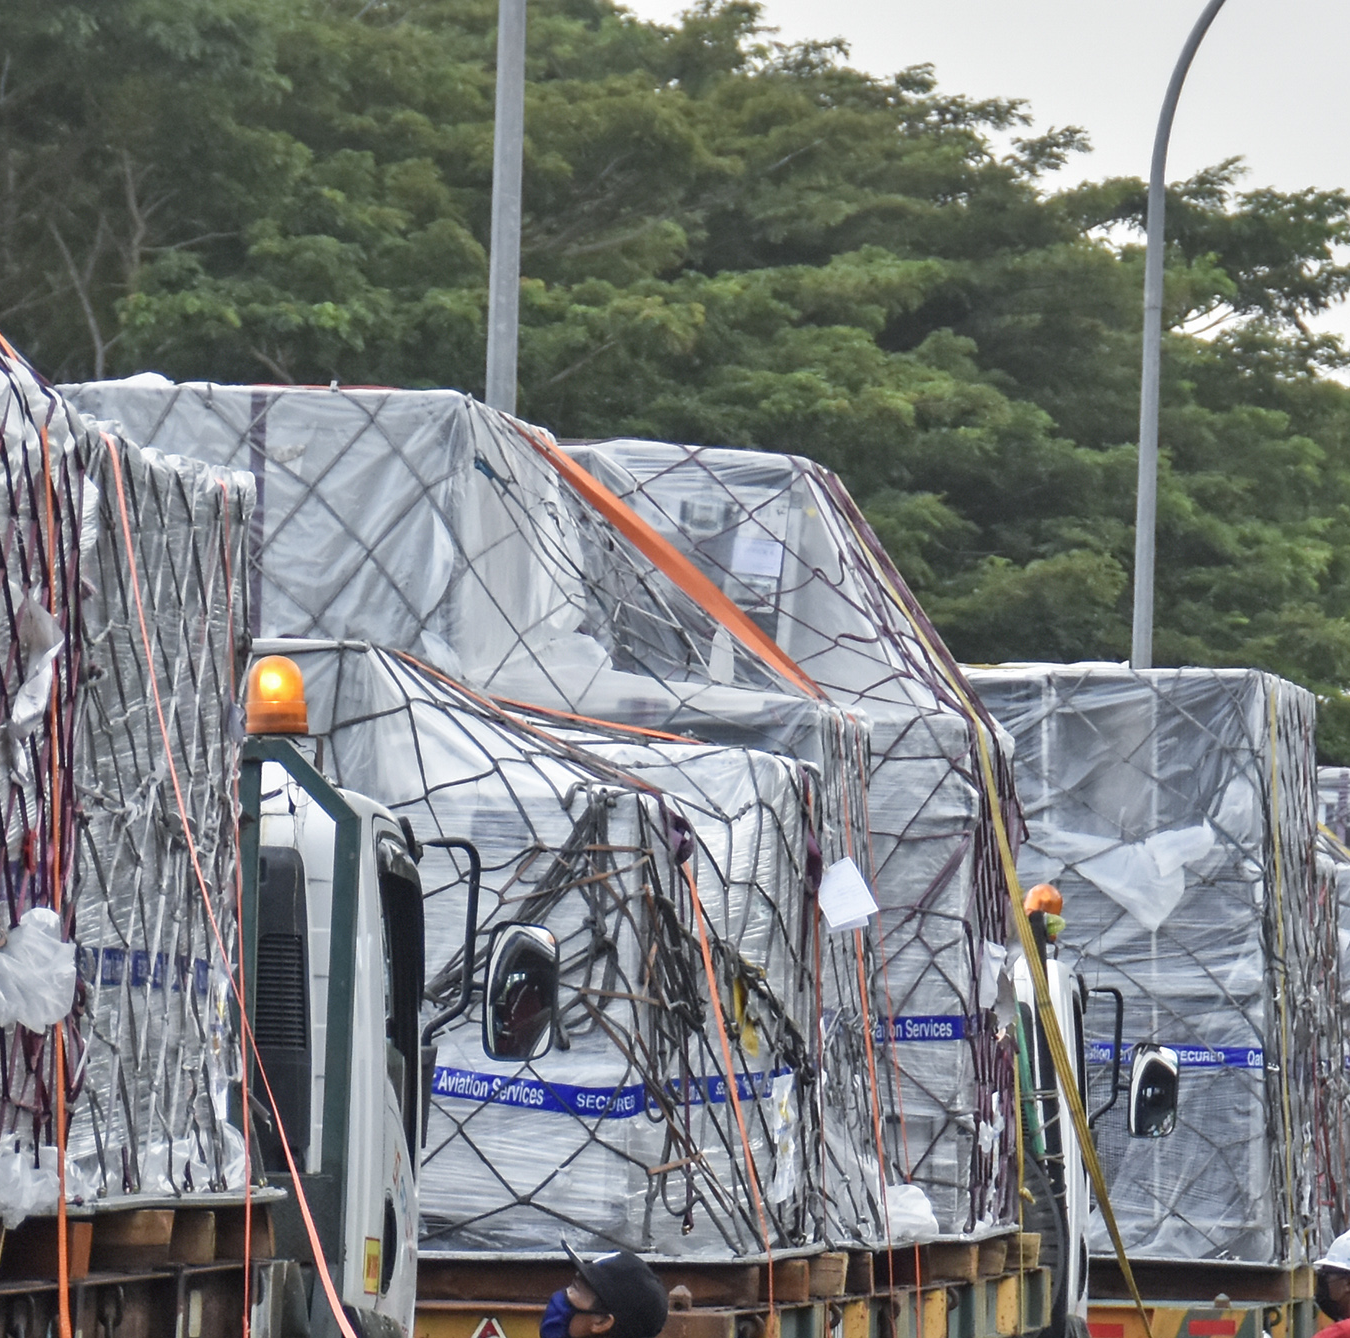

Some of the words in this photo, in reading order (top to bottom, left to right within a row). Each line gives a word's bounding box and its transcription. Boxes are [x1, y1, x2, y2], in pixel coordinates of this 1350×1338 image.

[905, 1019, 953, 1038] Services
[1176, 1049, 1225, 1063] ECURED
[1247, 1051, 1264, 1067] Qat
[438, 1069, 489, 1098] Aviation
[491, 1077, 544, 1106] Services
[576, 1092, 636, 1112] SECURED
